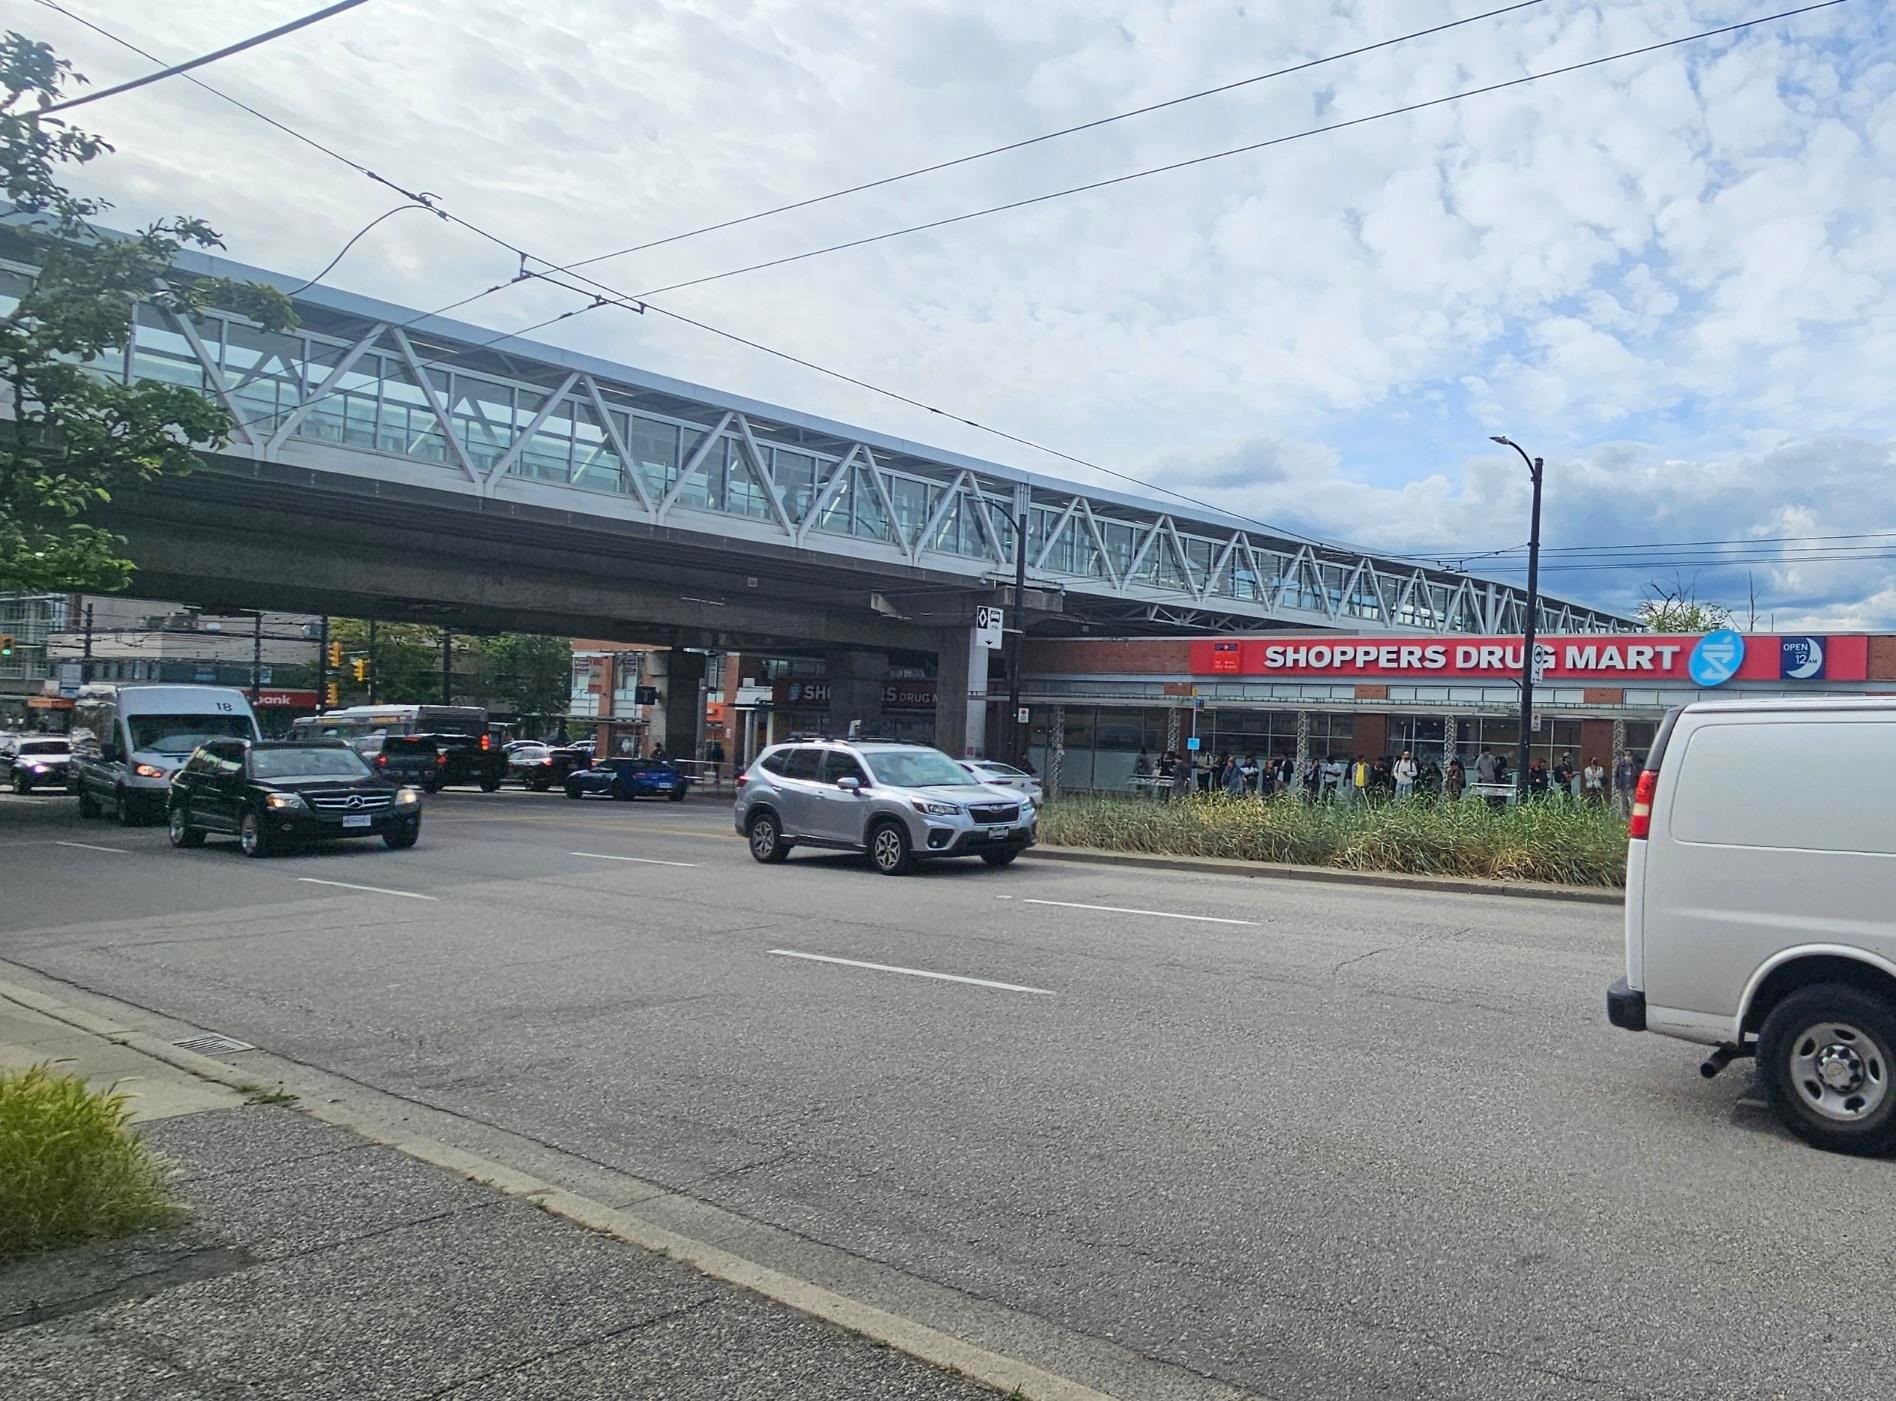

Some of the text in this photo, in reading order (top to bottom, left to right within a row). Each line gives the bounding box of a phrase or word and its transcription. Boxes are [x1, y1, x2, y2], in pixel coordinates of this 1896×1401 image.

[1783, 643, 1808, 651] OPEN
[1264, 645, 1681, 670] SHOPPERS DRUG MART
[1796, 654, 1807, 665] 12
[900, 692, 930, 703] DRUG
[216, 702, 233, 712] 18
